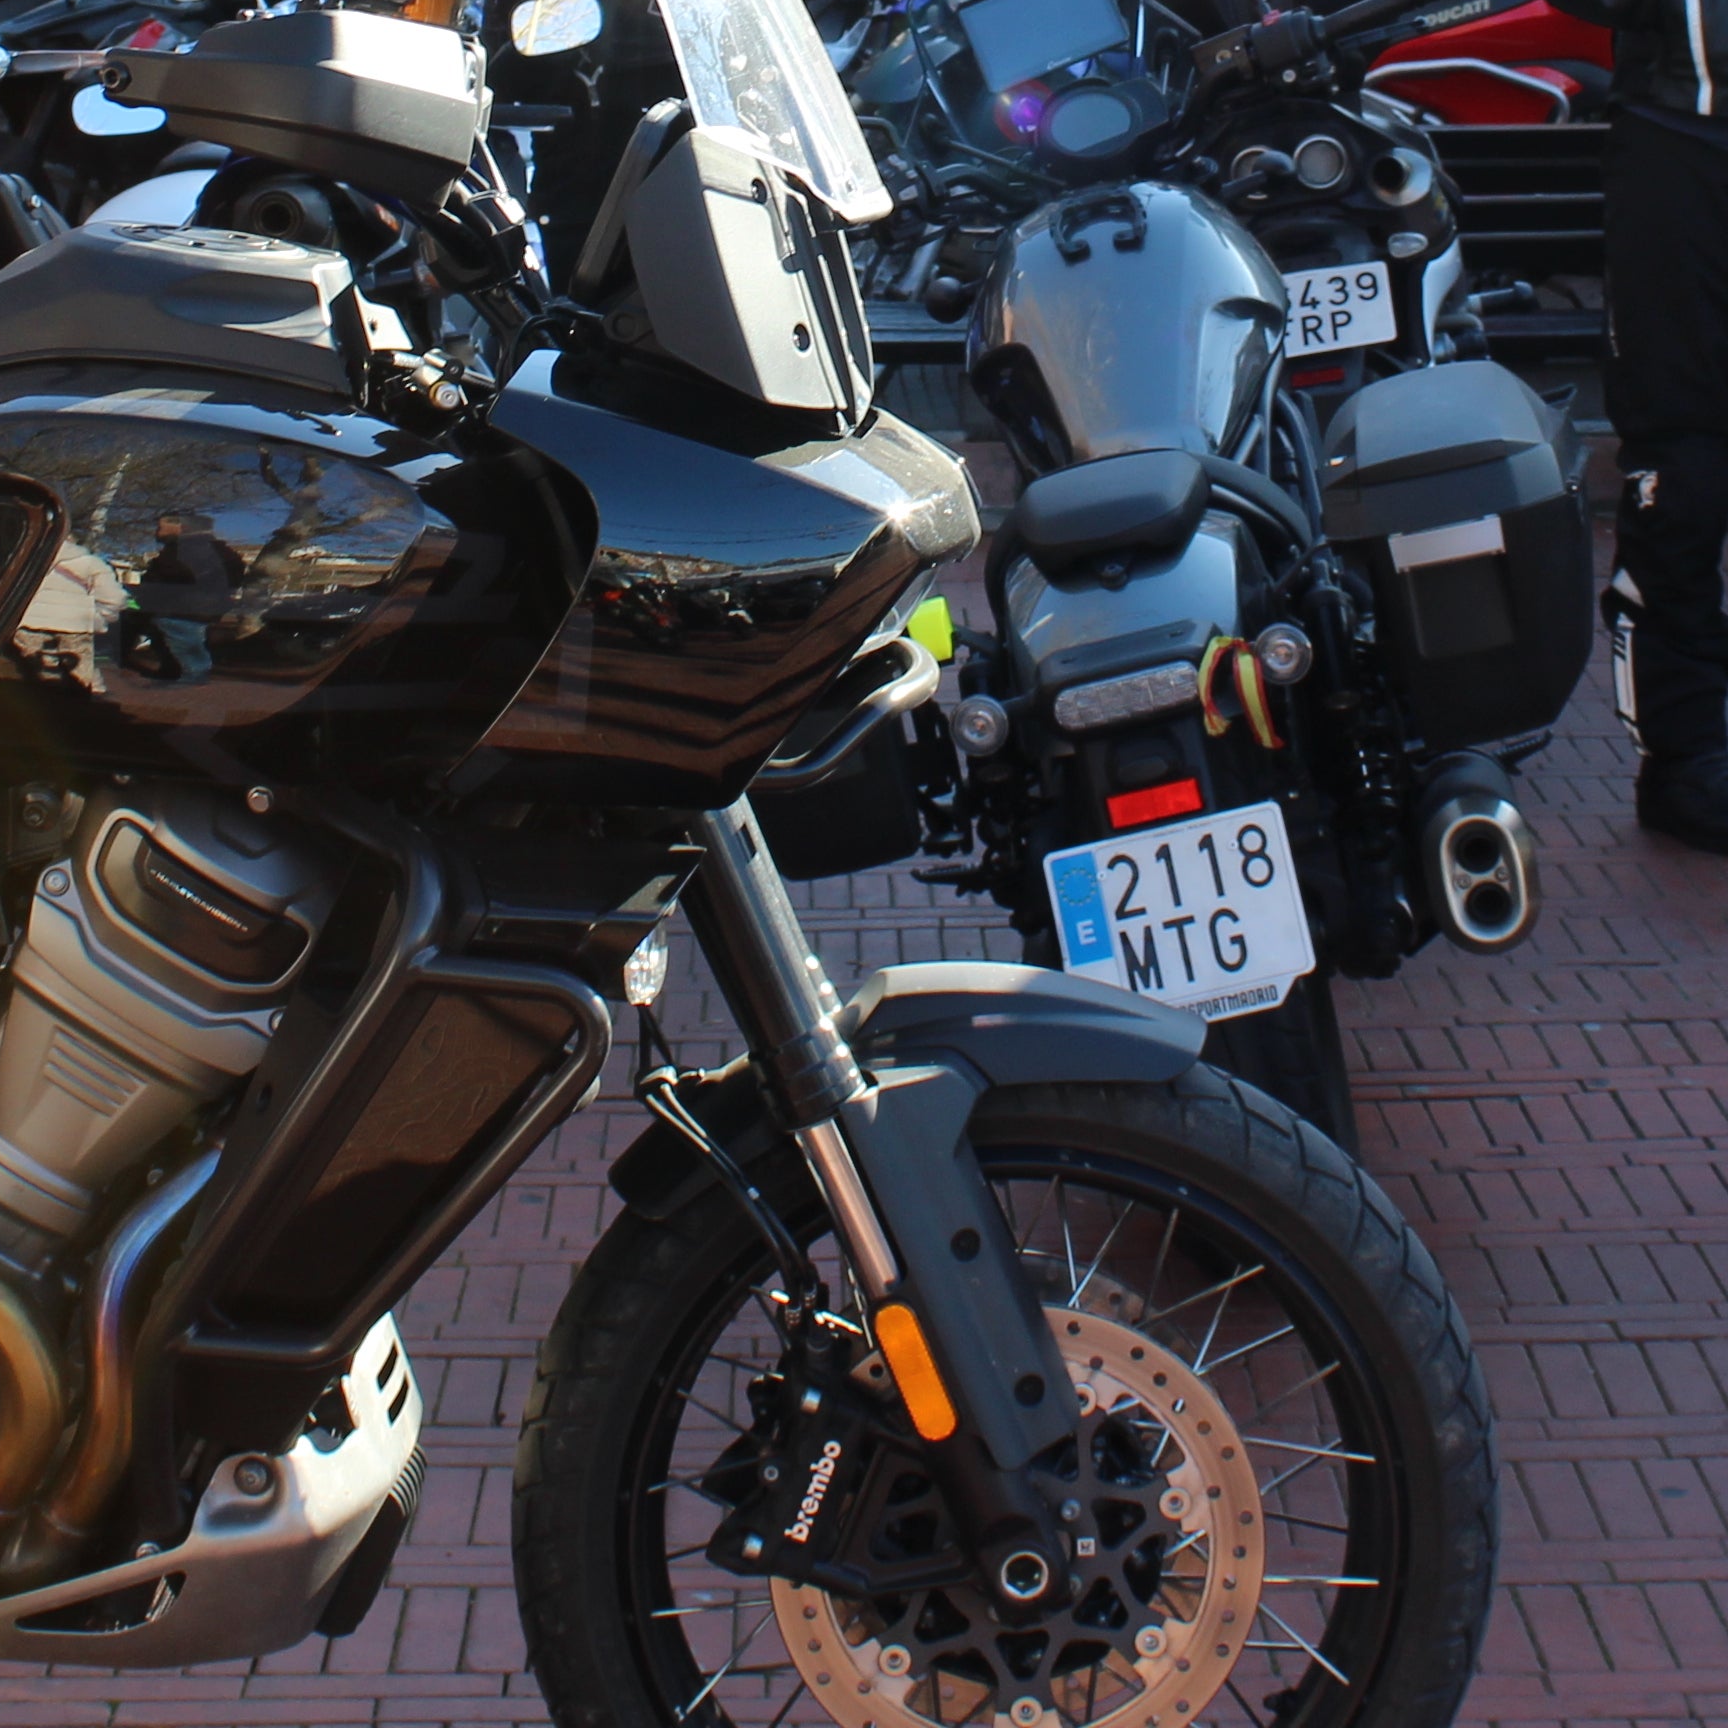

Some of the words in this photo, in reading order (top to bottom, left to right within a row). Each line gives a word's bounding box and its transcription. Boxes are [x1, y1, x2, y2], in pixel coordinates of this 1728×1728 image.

[1285, 272, 1379, 309] 439
[1285, 310, 1353, 347] RP
[1107, 824, 1275, 921] 2118
[1076, 920, 1098, 945] E
[1119, 908, 1248, 993] MTG
[783, 1439, 842, 1543] brembo
